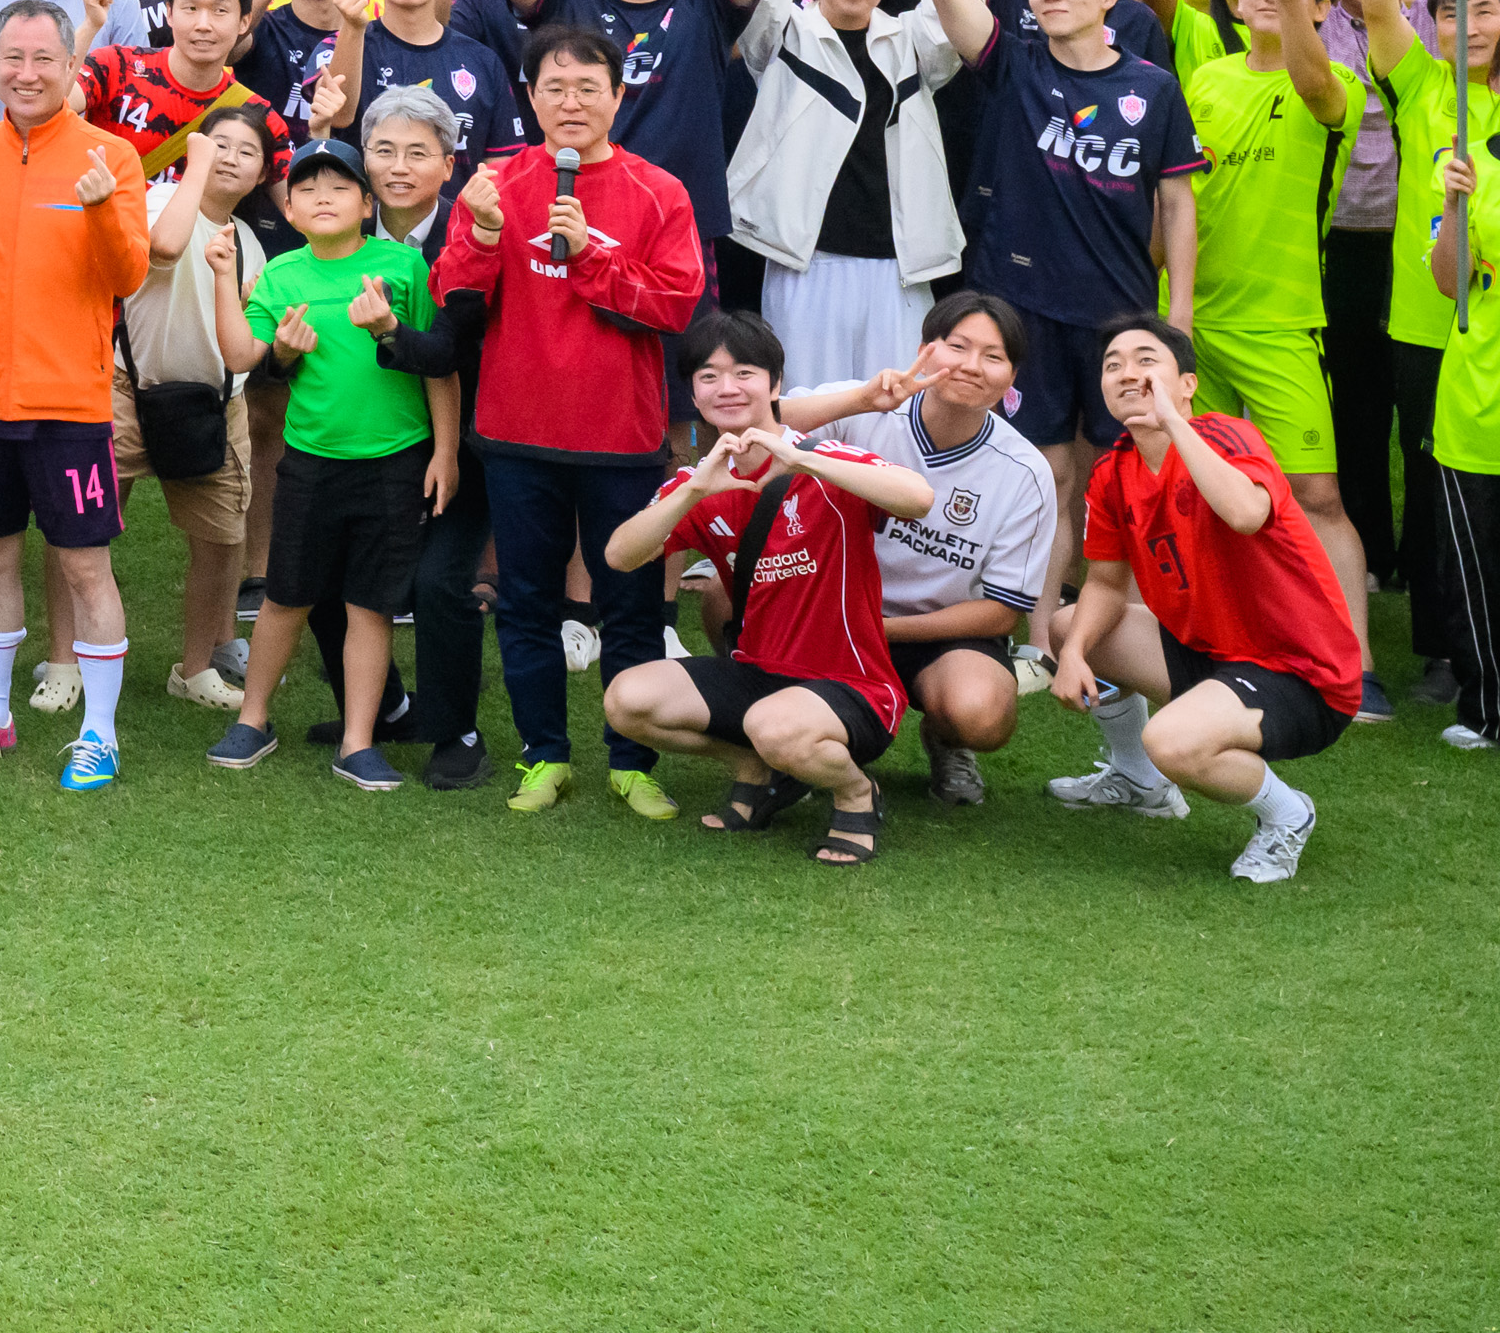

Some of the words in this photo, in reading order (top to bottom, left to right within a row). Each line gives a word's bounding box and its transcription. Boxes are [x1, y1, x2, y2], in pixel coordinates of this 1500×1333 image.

[118, 95, 151, 133] 14
[1036, 115, 1141, 178] NCC
[65, 463, 105, 514] 14
[888, 527, 976, 571] PACKARD
